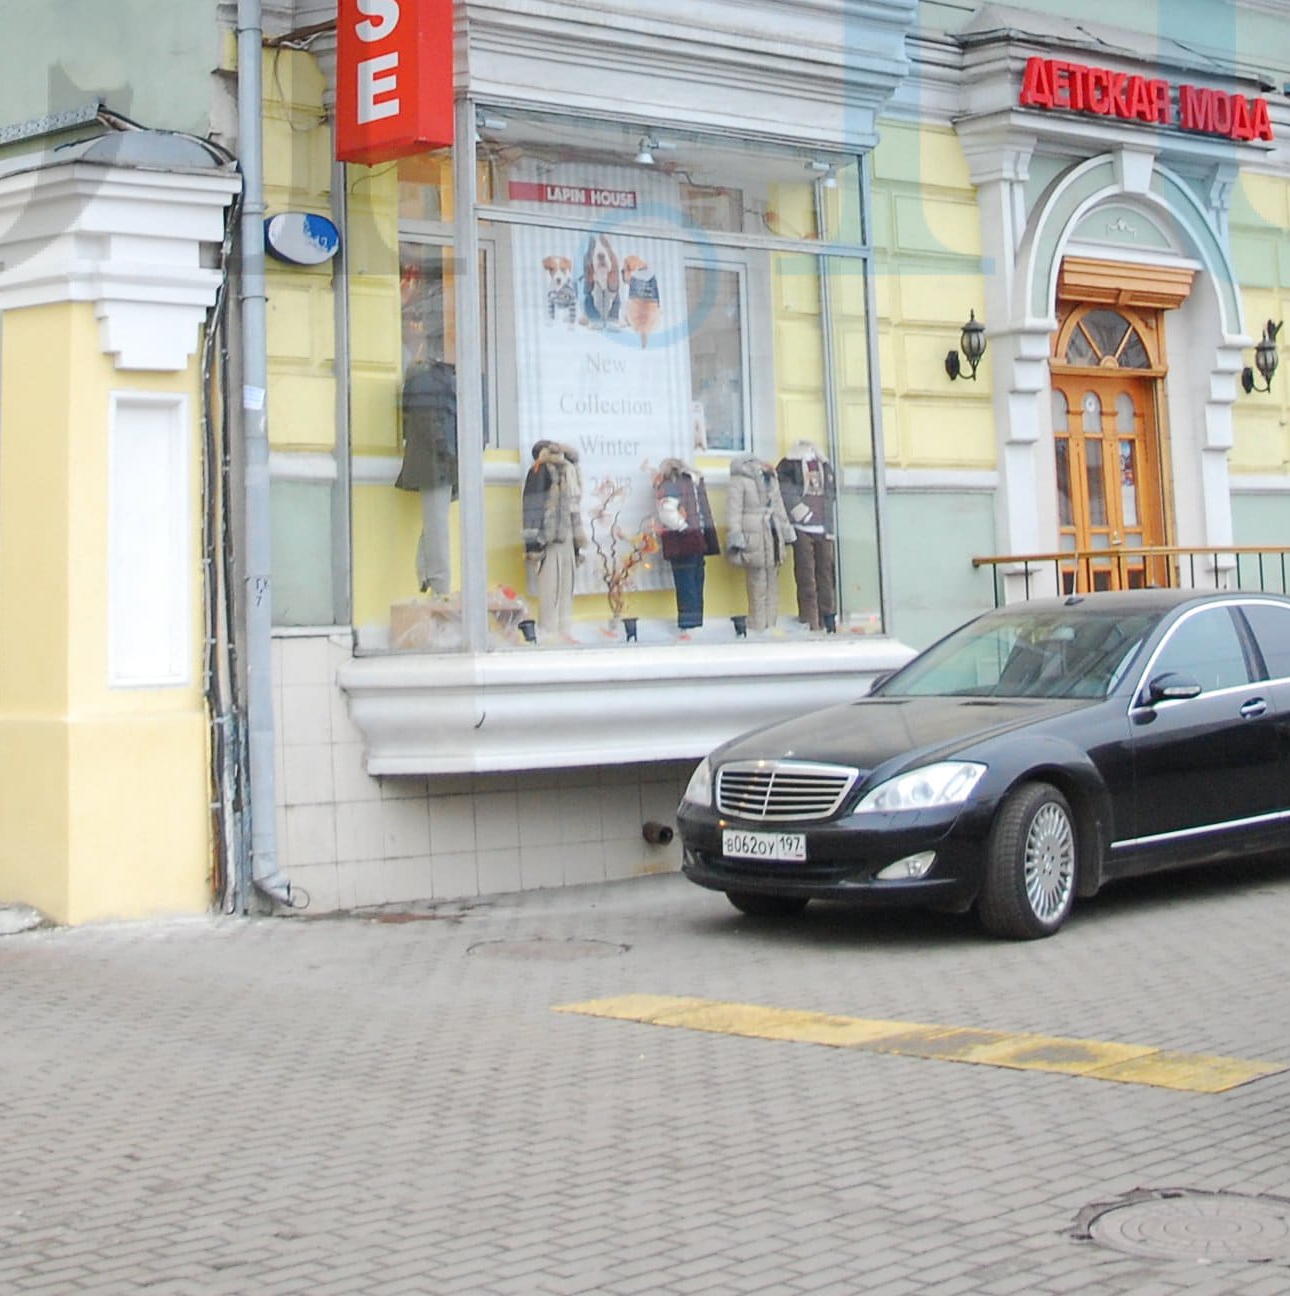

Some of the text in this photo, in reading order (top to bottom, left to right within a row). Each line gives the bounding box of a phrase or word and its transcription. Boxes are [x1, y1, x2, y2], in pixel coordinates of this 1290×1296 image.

[1020, 56, 1275, 142] ДЕТСКАЯ МОДА
[546, 186, 634, 208] LAPIN HOUSE
[586, 353, 626, 374] New
[559, 393, 653, 416] Collection
[579, 433, 641, 457] Winter
